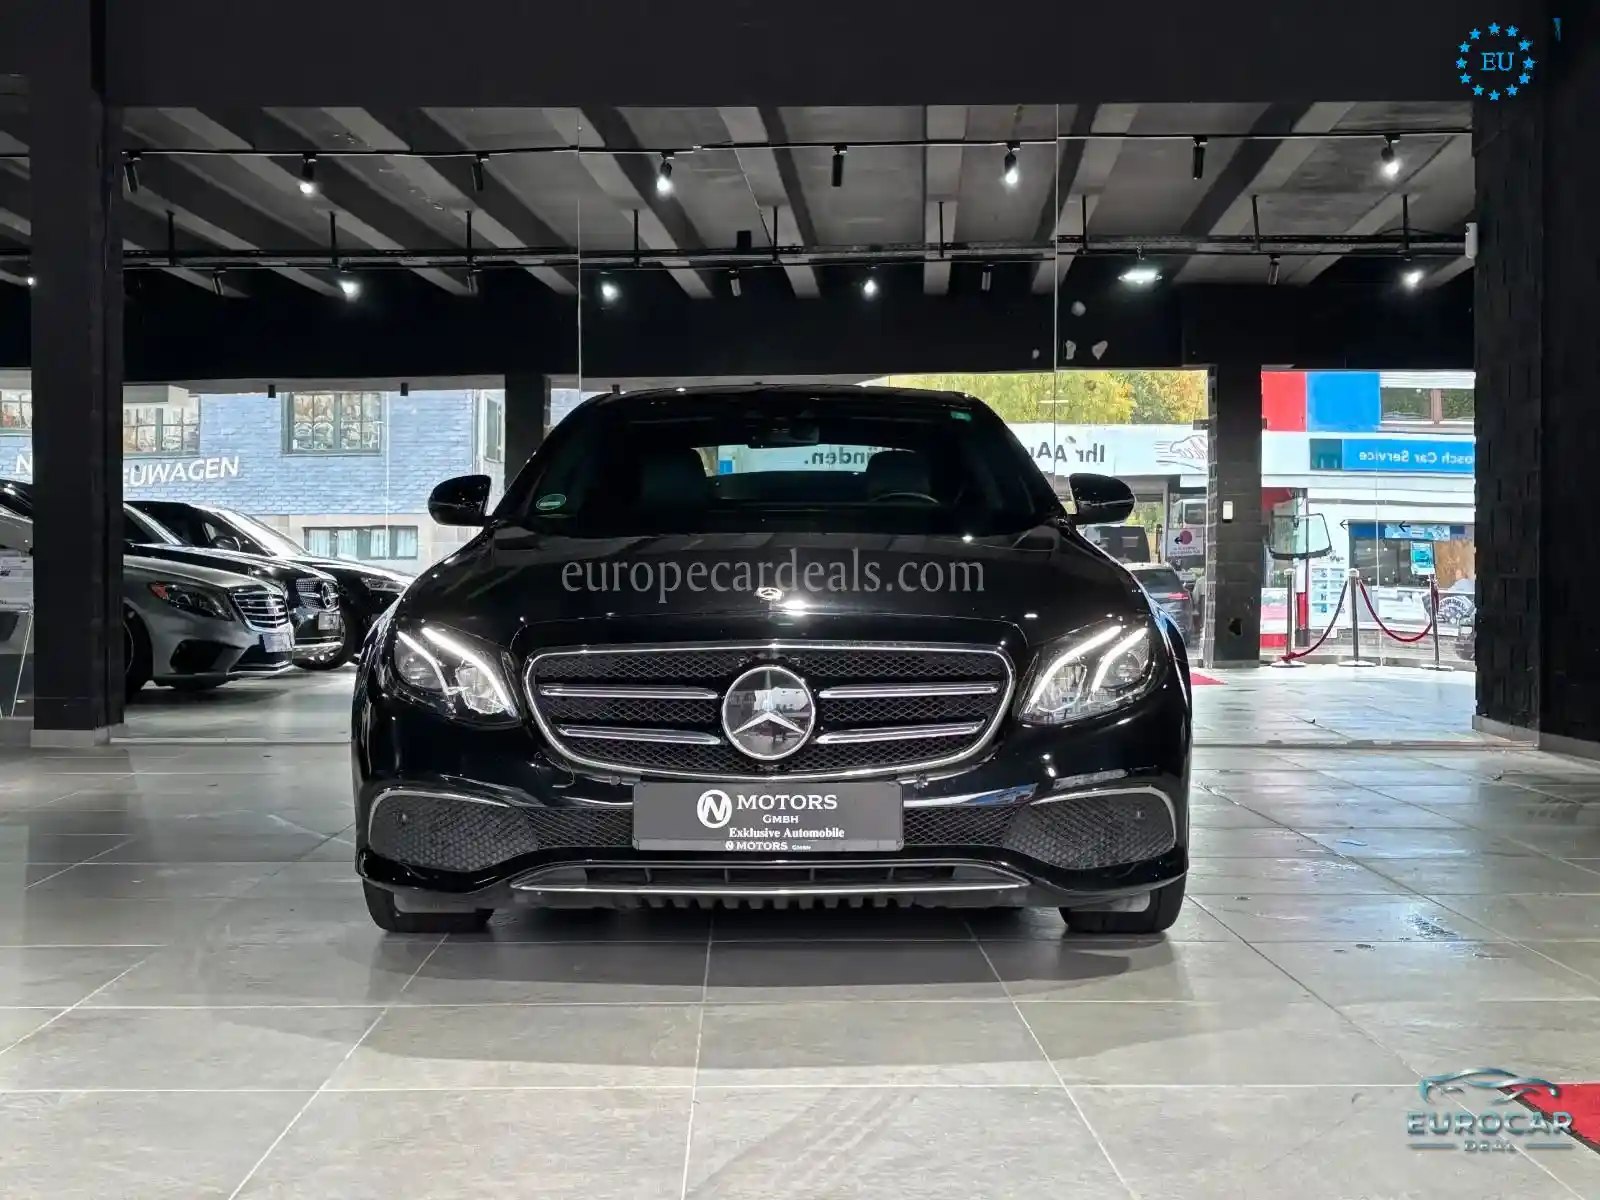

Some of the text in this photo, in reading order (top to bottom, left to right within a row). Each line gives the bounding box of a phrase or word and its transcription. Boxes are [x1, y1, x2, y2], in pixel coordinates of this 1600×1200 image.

[736, 794, 838, 811] MOTORS
[728, 827, 846, 839] Exklusive Automobile
[736, 841, 789, 851] MOTORS
